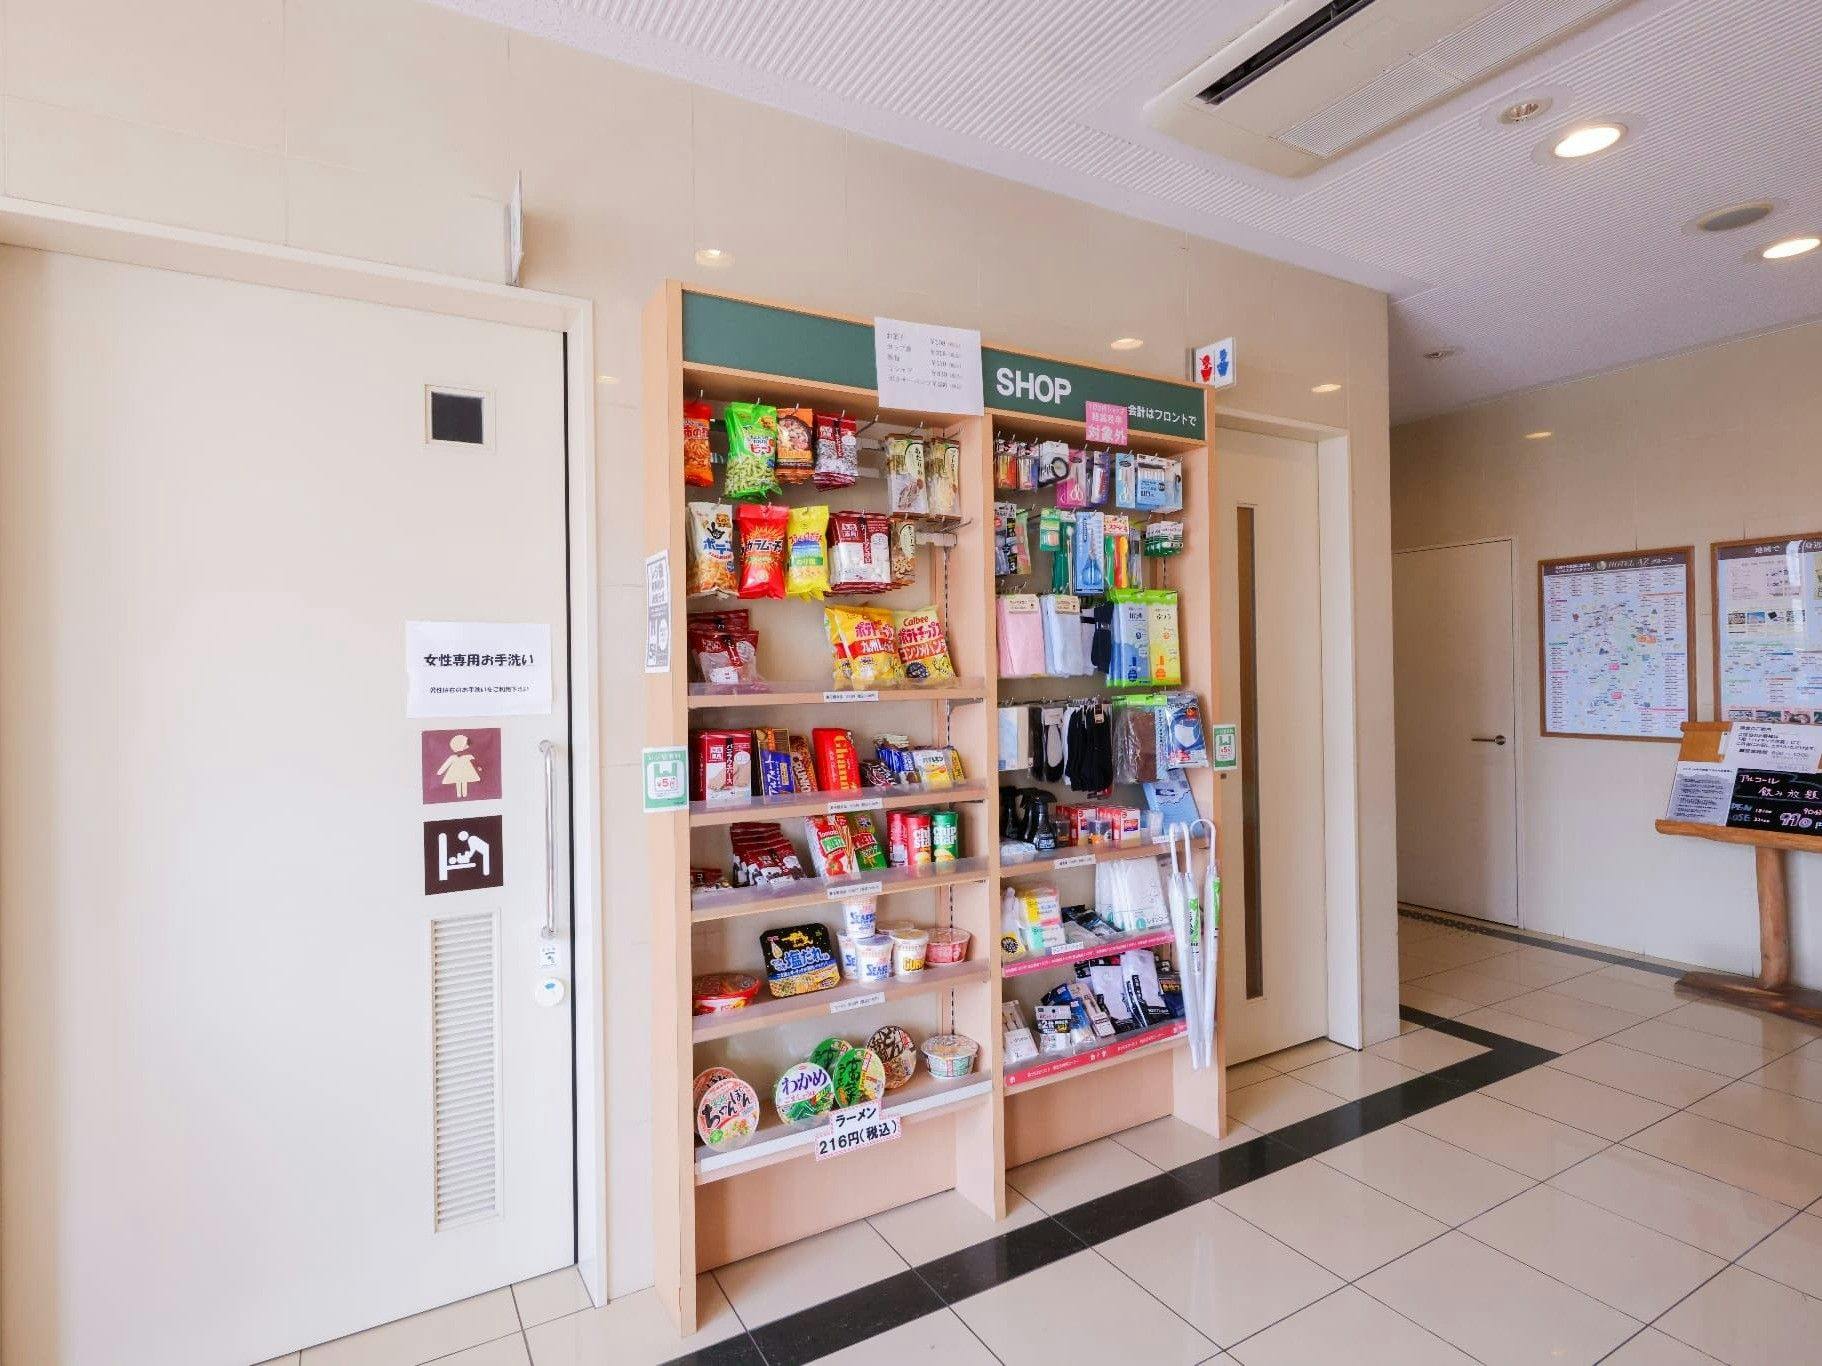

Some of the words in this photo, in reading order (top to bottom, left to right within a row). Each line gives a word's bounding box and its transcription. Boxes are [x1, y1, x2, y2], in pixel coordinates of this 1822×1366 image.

[996, 367, 1072, 404] SHOP
[1127, 404, 1197, 426] 会計はフロントで
[903, 615, 929, 627] Calbee
[424, 653, 534, 667] 女性専用お手洗い
[833, 735, 850, 790] Ghana
[1739, 774, 1780, 785] アルコール
[1758, 786, 1820, 800] 飲み放題
[781, 1069, 828, 1095] わかめ
[702, 1088, 751, 1128] ちゃんぽん
[836, 1107, 877, 1127] ラーメン
[819, 1120, 897, 1155] 216円(税込)
